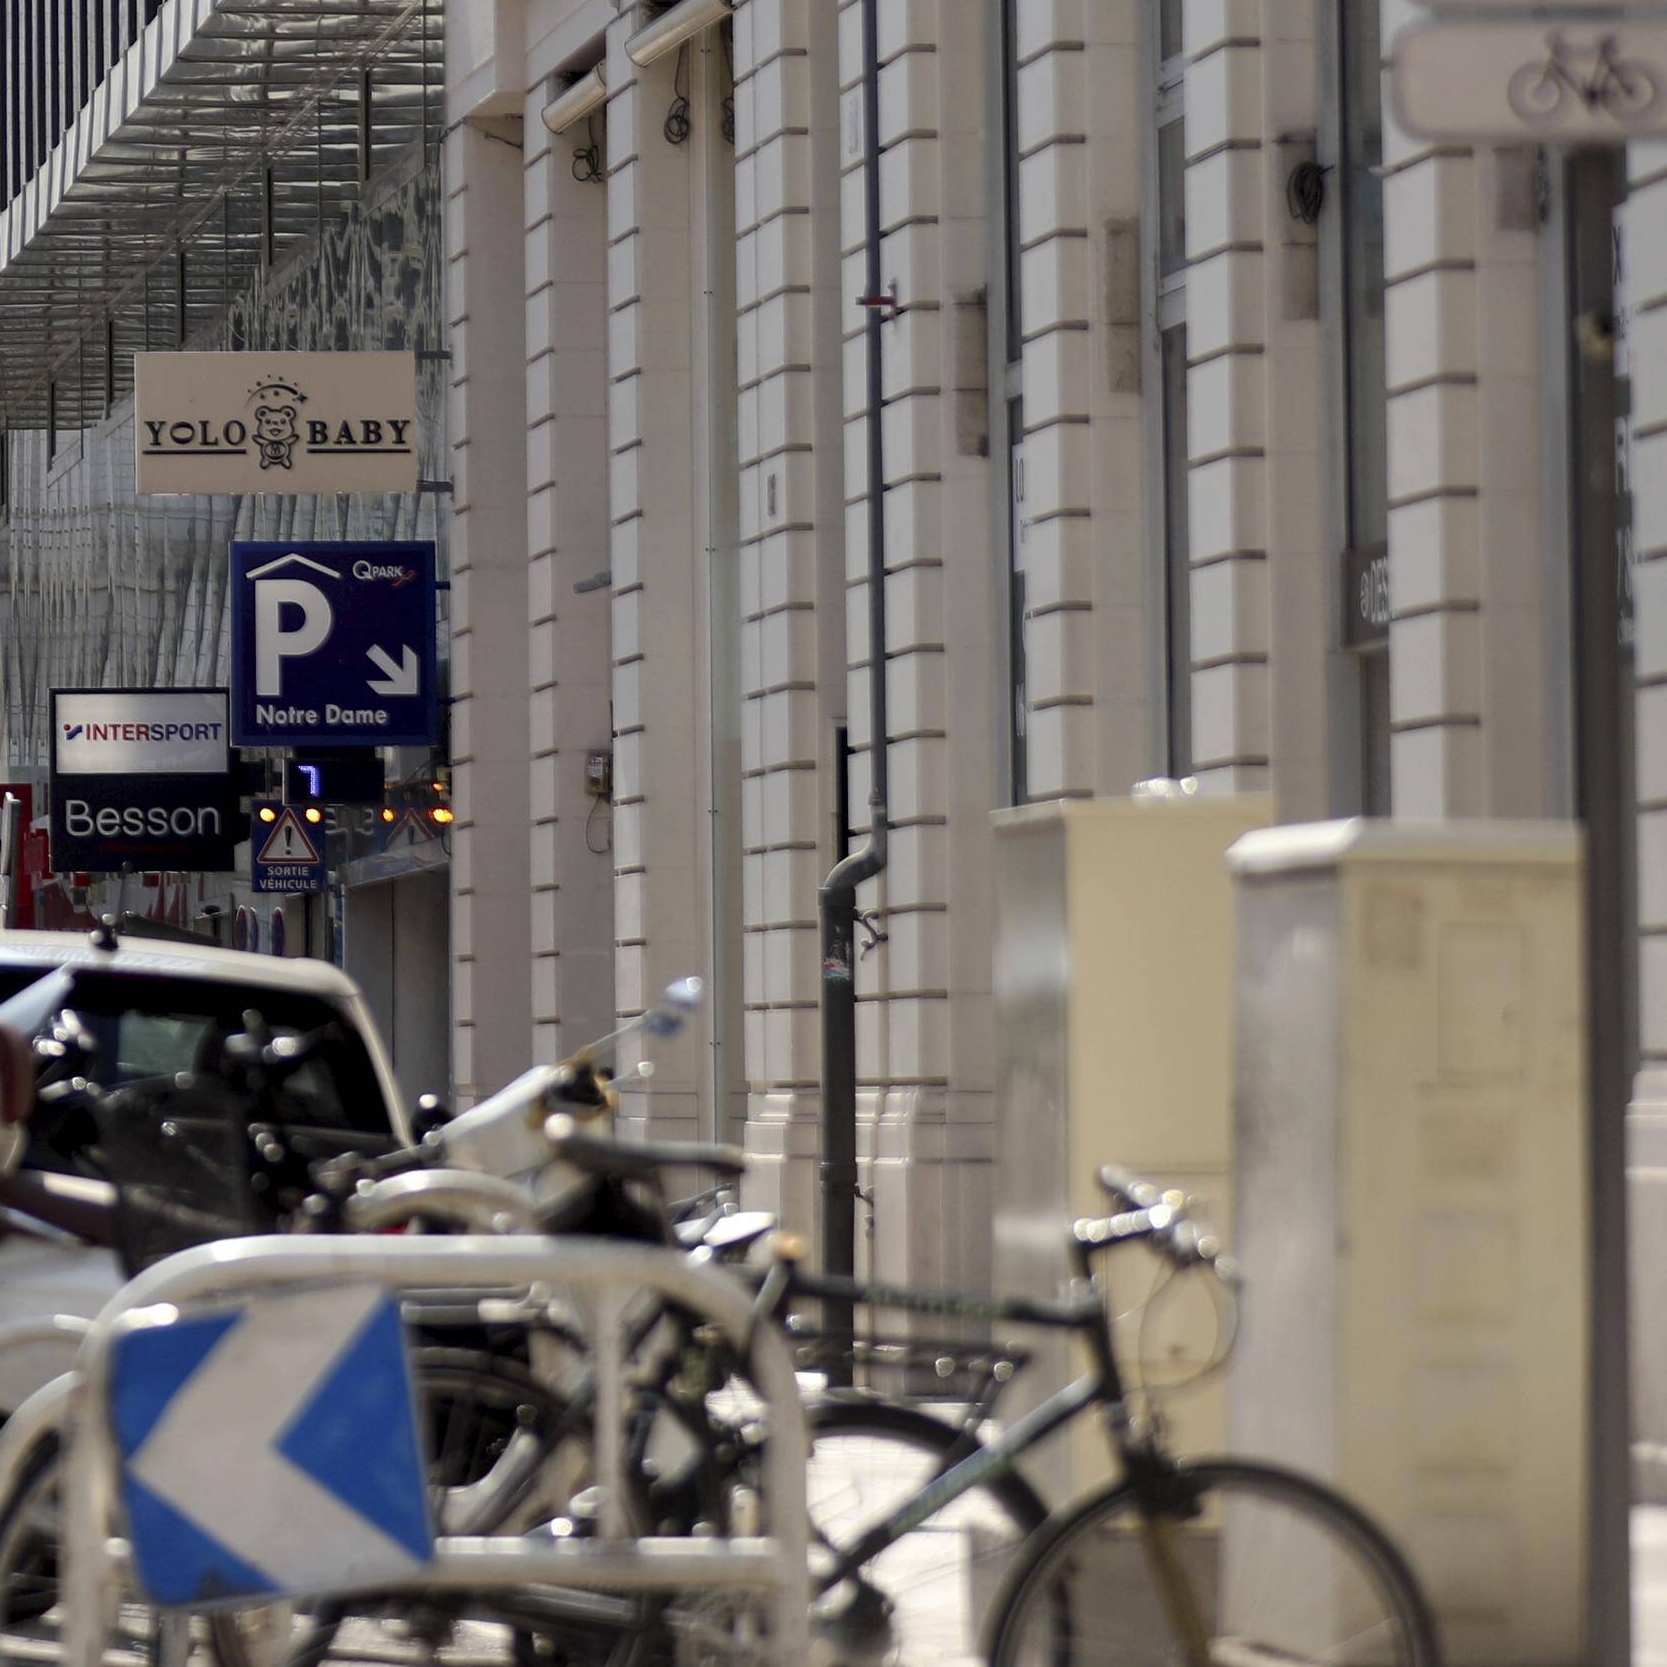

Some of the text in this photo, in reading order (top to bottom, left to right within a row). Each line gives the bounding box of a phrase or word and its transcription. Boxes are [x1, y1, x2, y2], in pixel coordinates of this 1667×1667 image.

[143, 419, 411, 446] YOLO BABY
[255, 579, 332, 697] P
[256, 704, 389, 725] Notre Dame
[86, 722, 223, 742] INTERSPORT
[64, 799, 220, 837] Besson
[266, 865, 309, 877] SORTIE
[259, 877, 317, 890] VÉHICULE
